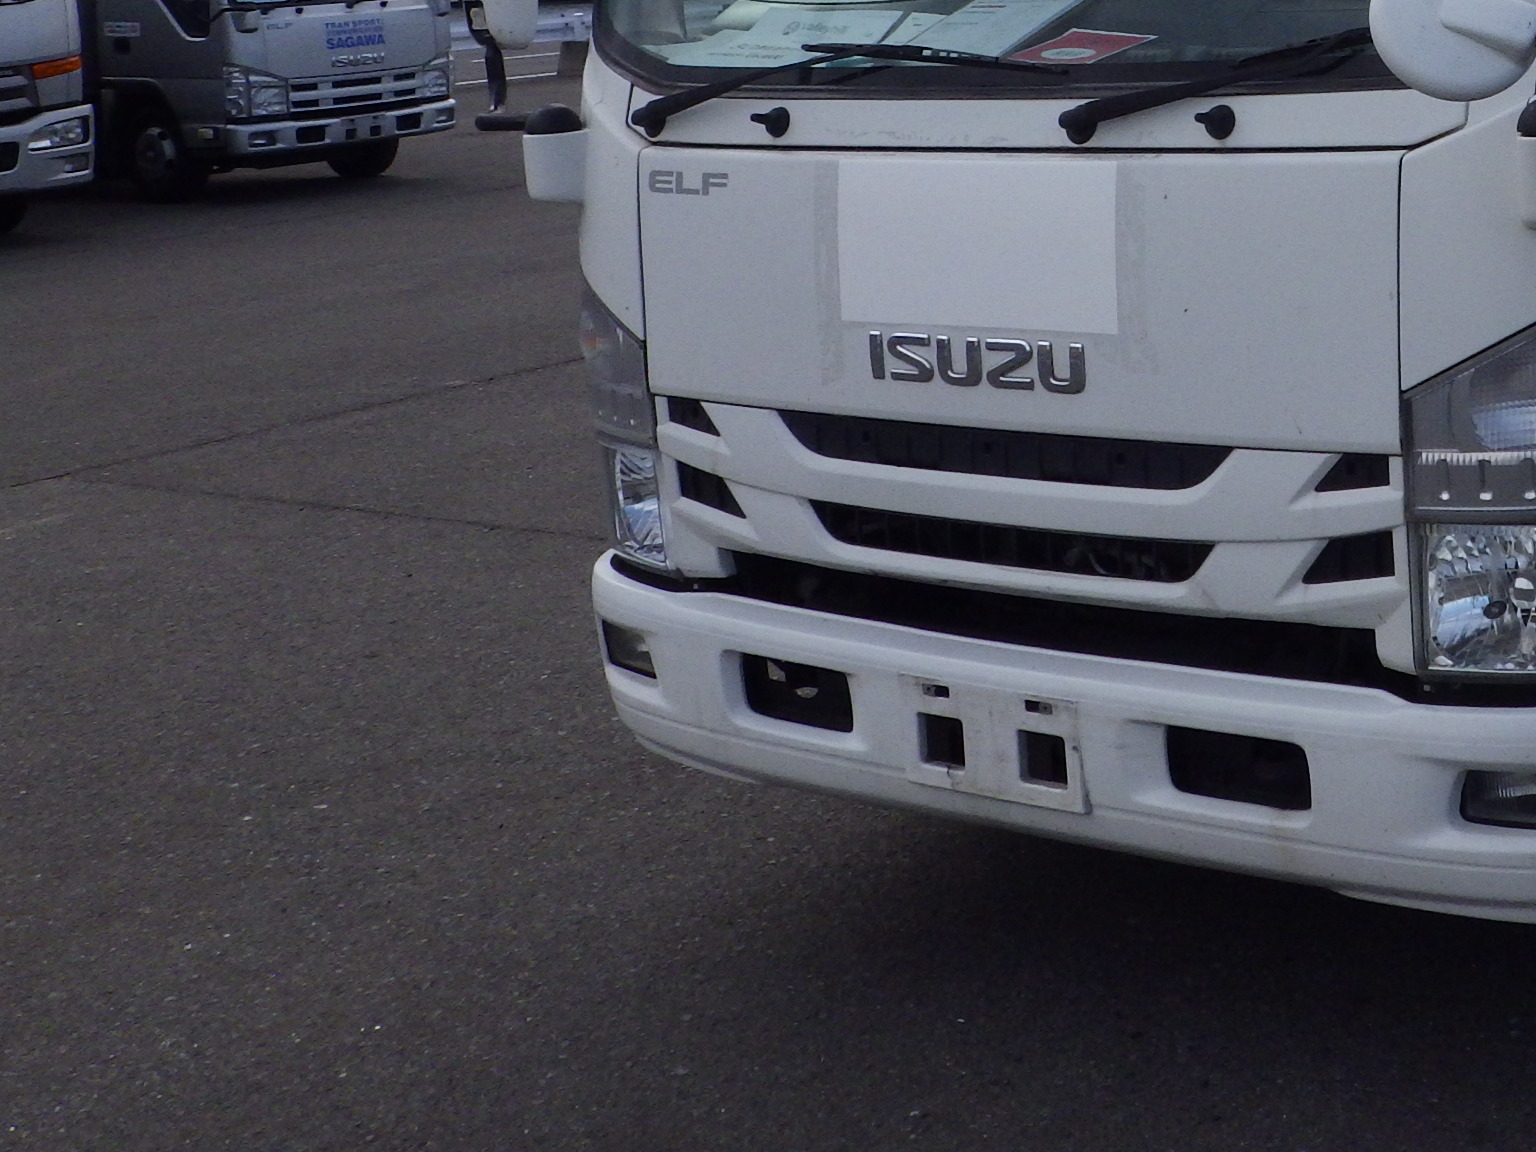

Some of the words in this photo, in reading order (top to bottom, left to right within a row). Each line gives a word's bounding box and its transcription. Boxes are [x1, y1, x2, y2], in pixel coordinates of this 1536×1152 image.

[326, 34, 386, 50] SAGAWA
[331, 52, 385, 68] ISUZU
[648, 170, 729, 196] ELF
[869, 330, 1087, 395] ISUZU
